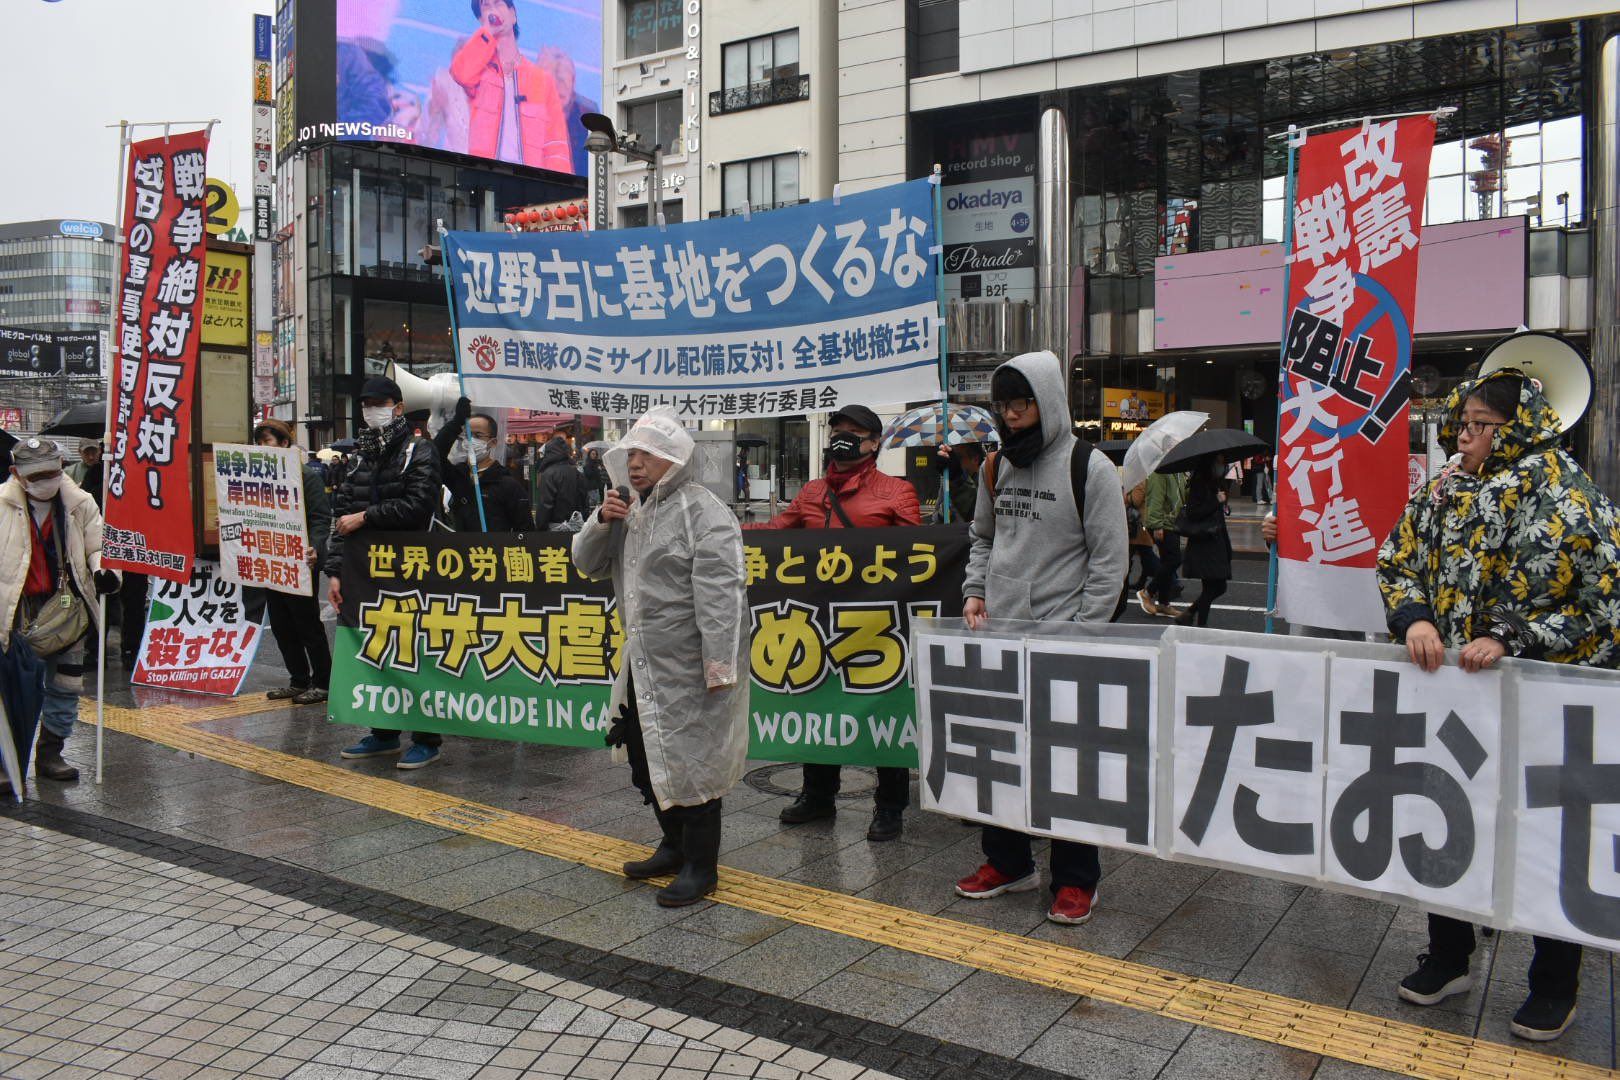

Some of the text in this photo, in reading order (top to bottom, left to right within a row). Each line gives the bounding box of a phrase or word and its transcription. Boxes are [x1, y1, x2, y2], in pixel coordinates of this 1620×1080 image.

[320, 122, 412, 139] 「NEWSmile」
[948, 154, 1021, 172] record shop
[617, 172, 685, 196] Cat afe
[1340, 119, 1419, 275] 改憲
[206, 184, 228, 226] 2
[947, 189, 1022, 210] okadaya
[64, 223, 98, 234] welcia
[975, 219, 993, 232] 生地
[457, 207, 927, 322] 辺野古に基地をつくるな
[944, 244, 1021, 272] Parade
[986, 284, 1008, 297] B2F
[136, 151, 205, 507] 戦争絶対反対！
[203, 314, 244, 328] はとバス
[8, 348, 30, 362] global
[66, 352, 84, 360] lobal
[468, 338, 480, 354] NO
[504, 316, 930, 377] 自衛隊のミサイル配備反対！ 全基地撤去！
[1111, 422, 1121, 430] POP
[1123, 422, 1137, 431] MART
[216, 449, 286, 480] 戦争反対！
[1281, 379, 1375, 565] 大行進
[227, 478, 299, 510] 岸田倒せ！
[102, 524, 146, 547] 塚芝山
[241, 528, 304, 560] 中国侵略
[237, 555, 299, 589] 戦争反対
[368, 544, 600, 583] 世界の労働者
[172, 598, 239, 626] 人々を
[146, 625, 256, 668] 殺すな！
[751, 602, 934, 690] めろ
[146, 669, 241, 683] Stop Killing in GAZA!
[352, 684, 918, 750] STOP GENOCIDE IN GA WORLD WA
